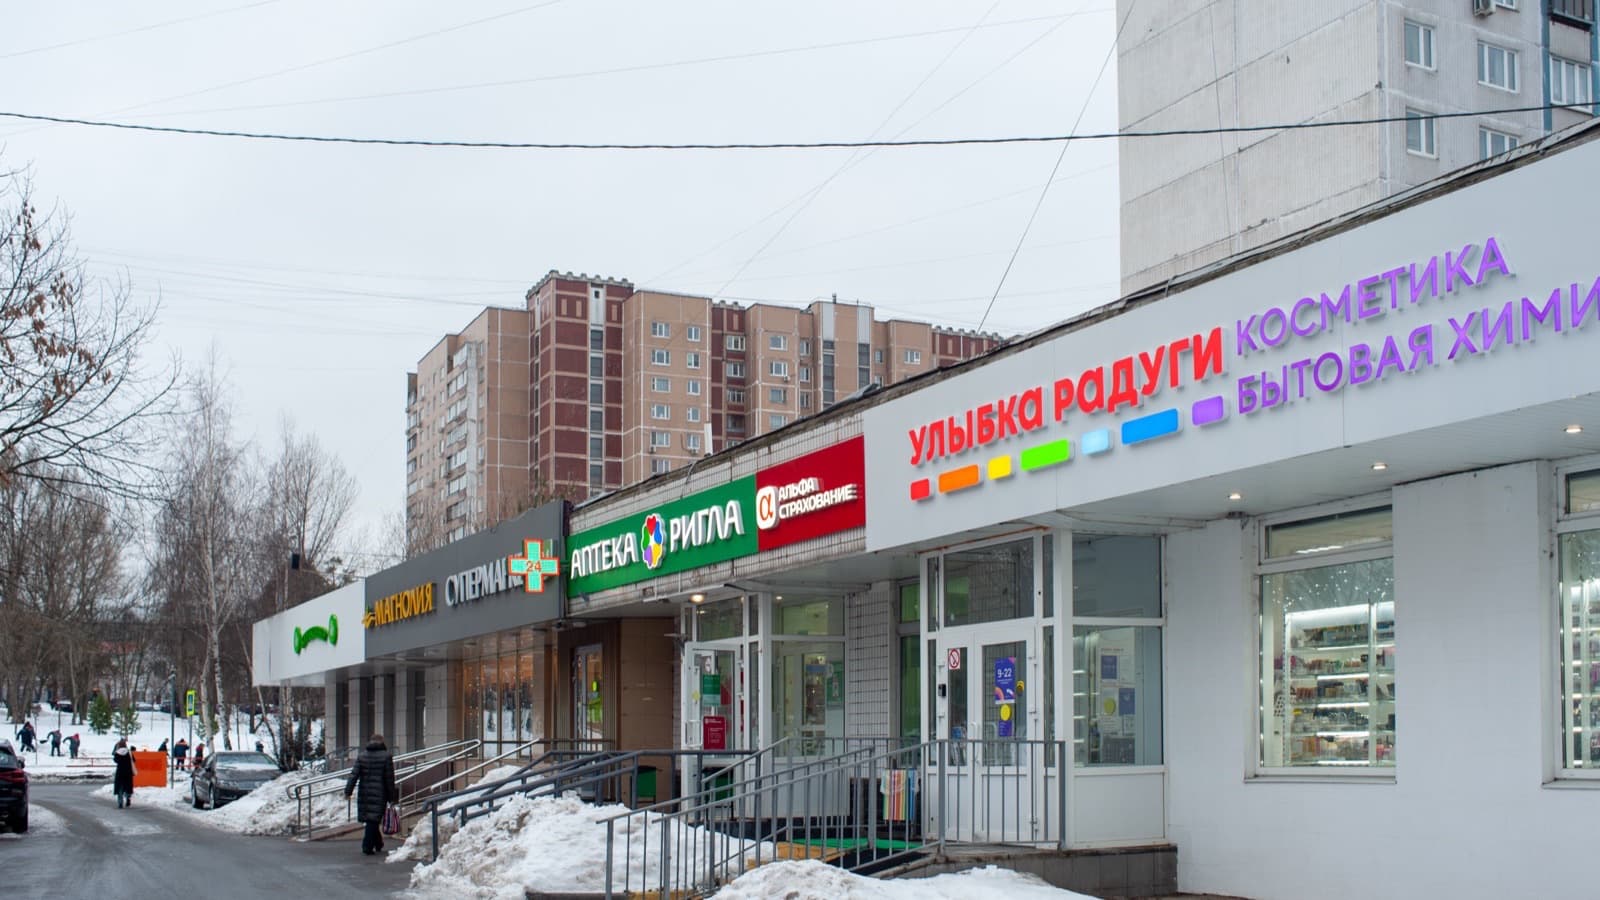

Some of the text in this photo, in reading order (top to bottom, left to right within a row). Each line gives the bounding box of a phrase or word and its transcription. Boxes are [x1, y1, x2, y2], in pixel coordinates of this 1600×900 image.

[1237, 236, 1510, 356] КОСМЕТИКА
[1238, 323, 1434, 415] БЫТОВАЯ
[779, 477, 819, 501] АЛЬФА
[779, 483, 858, 519] СТРАХОВАНИЕ
[570, 500, 743, 580] АПТЕКА РИГЛА
[526, 560, 542, 573] 24
[374, 582, 433, 627] МАГНОЛИЯ
